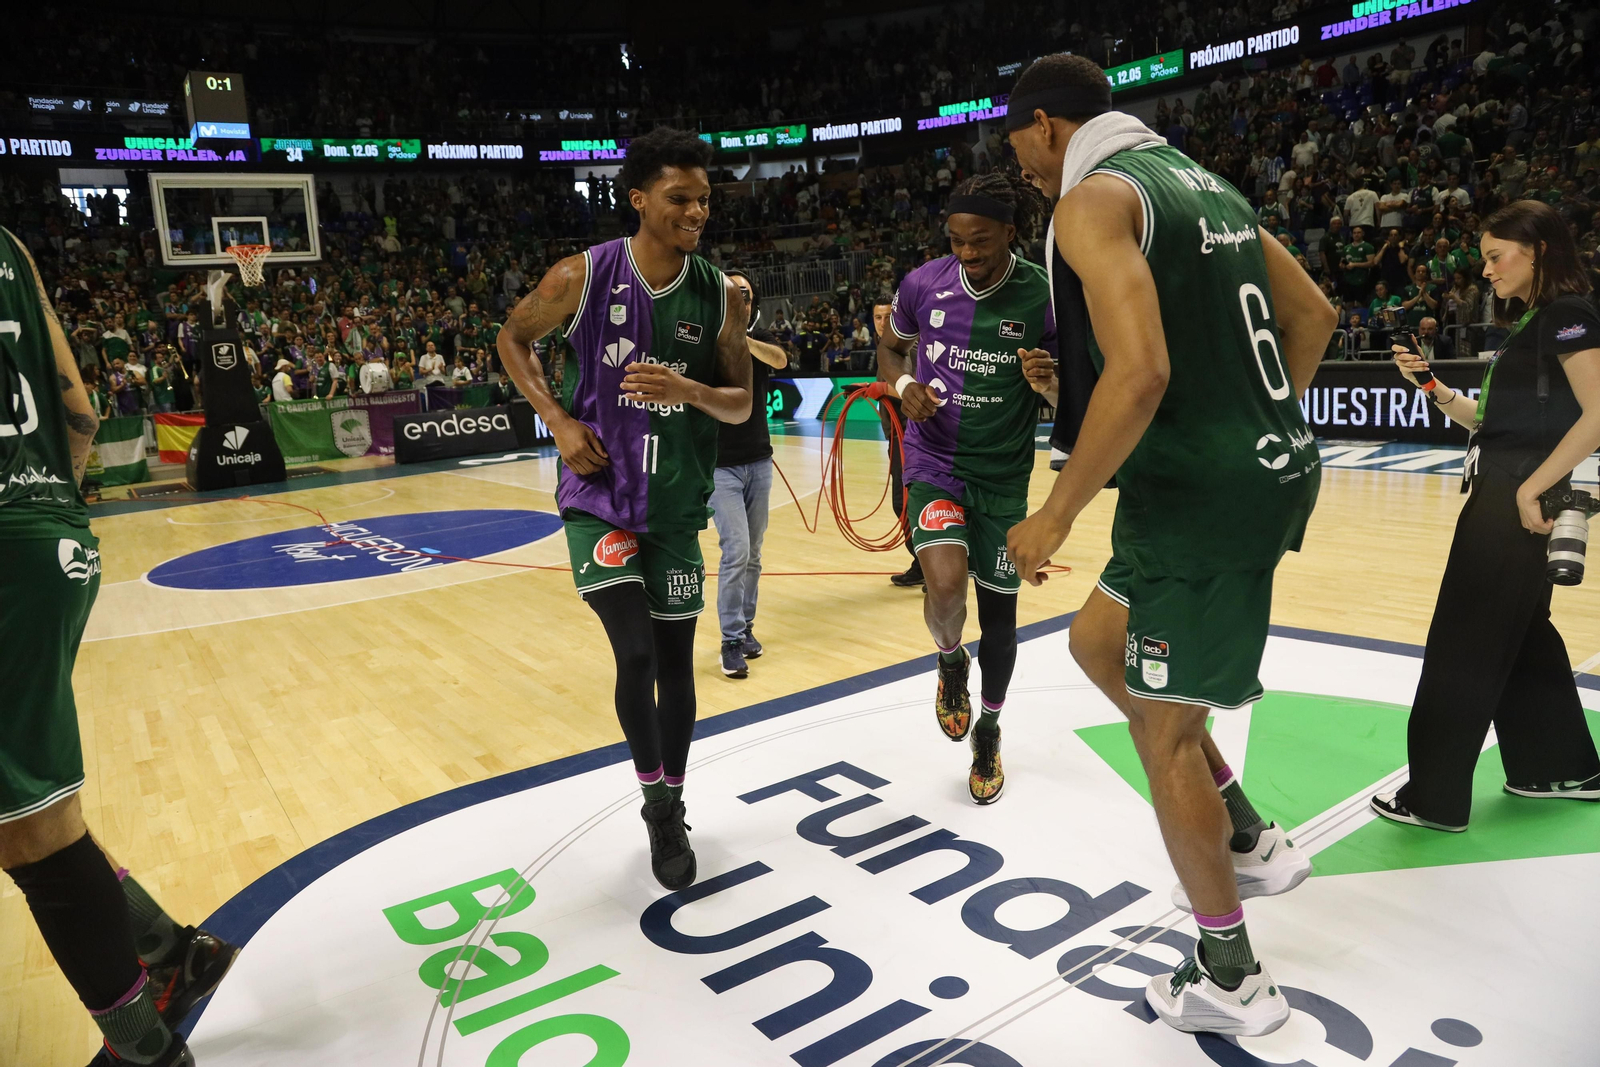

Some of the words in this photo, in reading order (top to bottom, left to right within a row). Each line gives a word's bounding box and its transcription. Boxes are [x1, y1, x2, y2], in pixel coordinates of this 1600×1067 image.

[1321, 10, 1392, 41] ZUNDER
[1190, 40, 1244, 70] PRÓXIMO
[1247, 25, 1300, 56] PARTIDO
[1150, 62, 1164, 72] liga
[1150, 65, 1179, 79] endesa
[1117, 66, 1142, 84] 12.05
[206, 76, 232, 91] 0:1
[938, 98, 992, 117] UNICAJA
[569, 113, 594, 121] Unicaja
[917, 113, 966, 131] ZUNDER
[968, 105, 1009, 122] PALEN
[220, 128, 248, 136] Movistar
[776, 133, 789, 141] liga
[812, 122, 859, 143] PRÓXIMO
[861, 117, 902, 136] PARTIDO
[9, 138, 73, 157] PARTIDO
[274, 139, 314, 150] JORNADA
[561, 139, 617, 151] UNICAJA
[720, 136, 744, 149] Dom.
[745, 133, 769, 147] 12.05
[776, 136, 803, 145] endesa
[95, 148, 163, 161] ZUNDER
[286, 147, 304, 162] 34
[324, 144, 350, 158] Dom.
[351, 144, 379, 157] 12.05
[387, 145, 402, 153] liga
[388, 152, 418, 160] endesa
[427, 141, 478, 160] PRÓXIMO
[480, 144, 524, 160] PARTIDO
[539, 150, 590, 162] ZUNDER
[1238, 283, 1290, 400] 6
[949, 344, 1017, 364] Fundación
[948, 357, 997, 377] Unicaja
[325, 399, 354, 409] TEMPLO
[952, 393, 977, 402] COSTA
[979, 395, 990, 403] DEL
[952, 399, 981, 409] MÁLAGA
[1299, 387, 1430, 428] NUESTRA
[403, 412, 511, 441] endesa
[216, 451, 262, 466] Unicaja
[642, 433, 660, 475] 11
[673, 567, 699, 586] má
[668, 581, 700, 600] laga
[1144, 645, 1162, 655] acb
